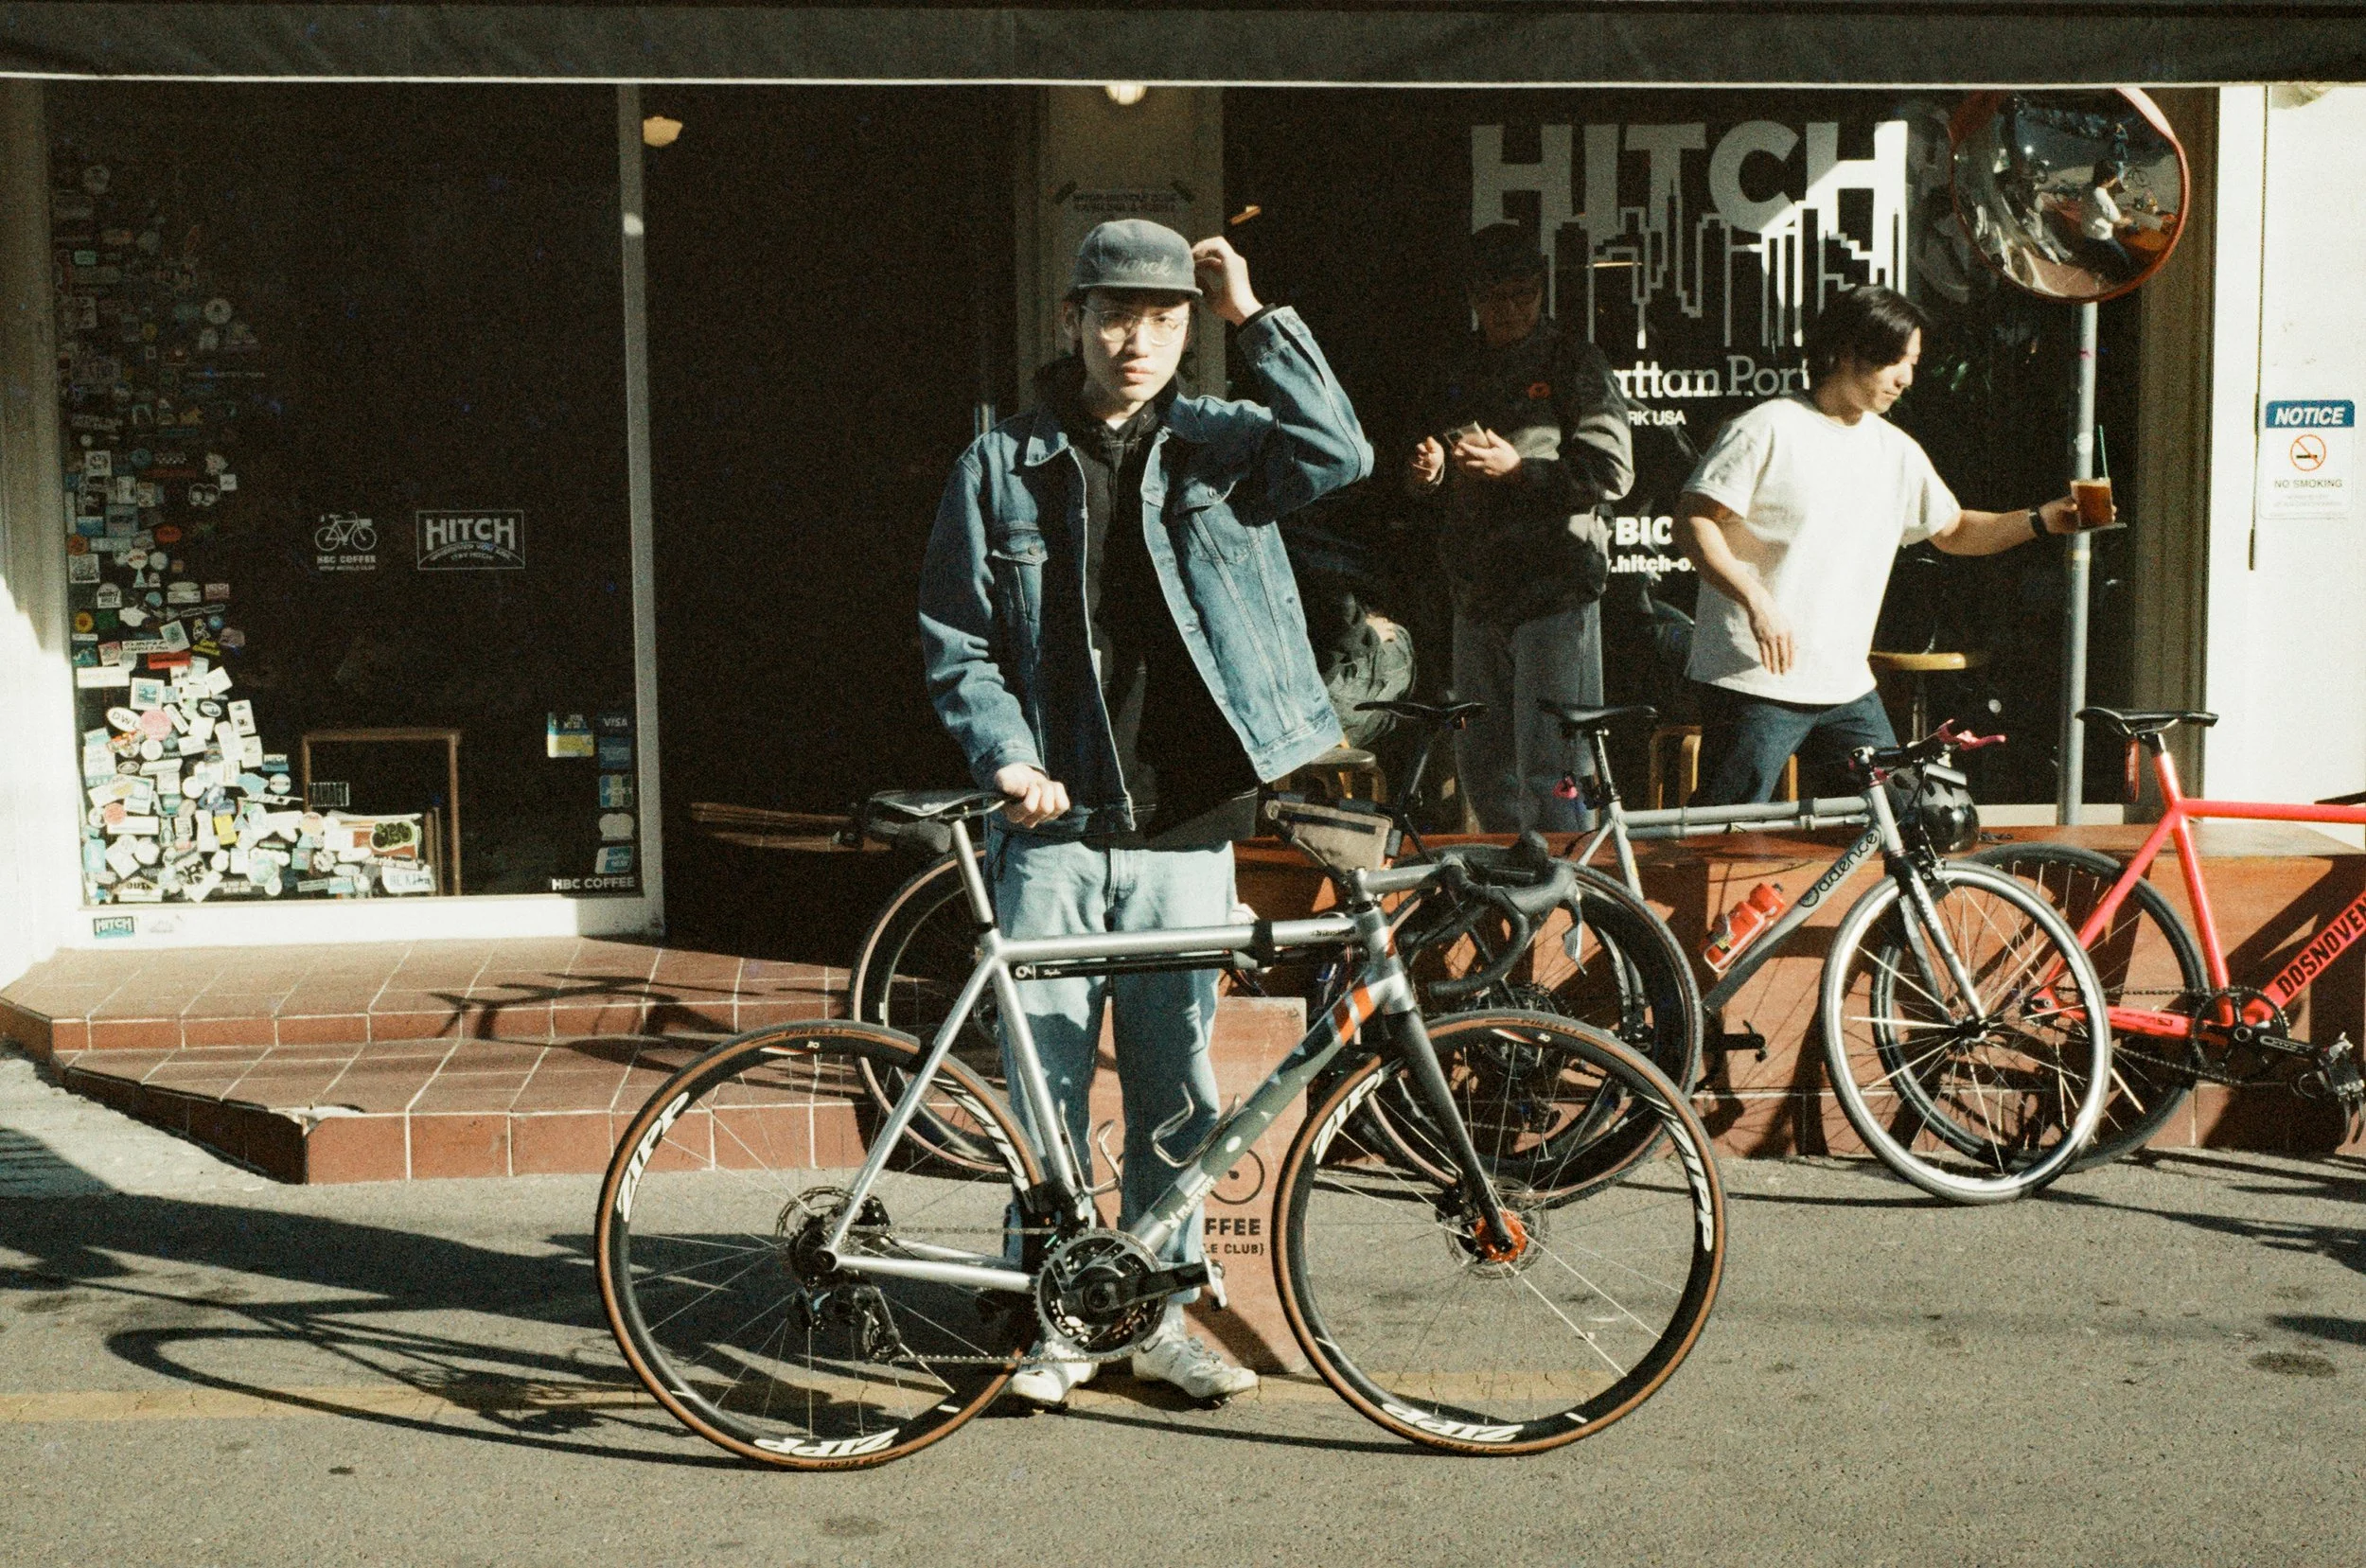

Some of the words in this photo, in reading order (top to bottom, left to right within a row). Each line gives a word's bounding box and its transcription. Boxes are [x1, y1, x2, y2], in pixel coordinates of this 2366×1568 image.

[1472, 120, 1908, 293] HITCH
[1652, 410, 1686, 425] USA
[2274, 406, 2345, 425] NOTICE
[2274, 480, 2289, 488] NO
[2292, 479, 2342, 488] SMOKING
[426, 519, 516, 551] HITCH
[1616, 516, 1673, 545] BIC
[603, 717, 628, 728] VISA
[1798, 833, 1878, 907] Cadence
[551, 878, 581, 890] HBC
[584, 877, 636, 890] COFFEE
[96, 918, 132, 932] HITCH
[616, 1092, 689, 1222] ZIPP
[1633, 1089, 1714, 1252] ZIPP
[1205, 1218, 1261, 1236] FFEE
[1225, 1243, 1264, 1256] CLUB)
[1382, 1403, 1524, 1442] ZIPP
[753, 1428, 899, 1457] ZIPP
